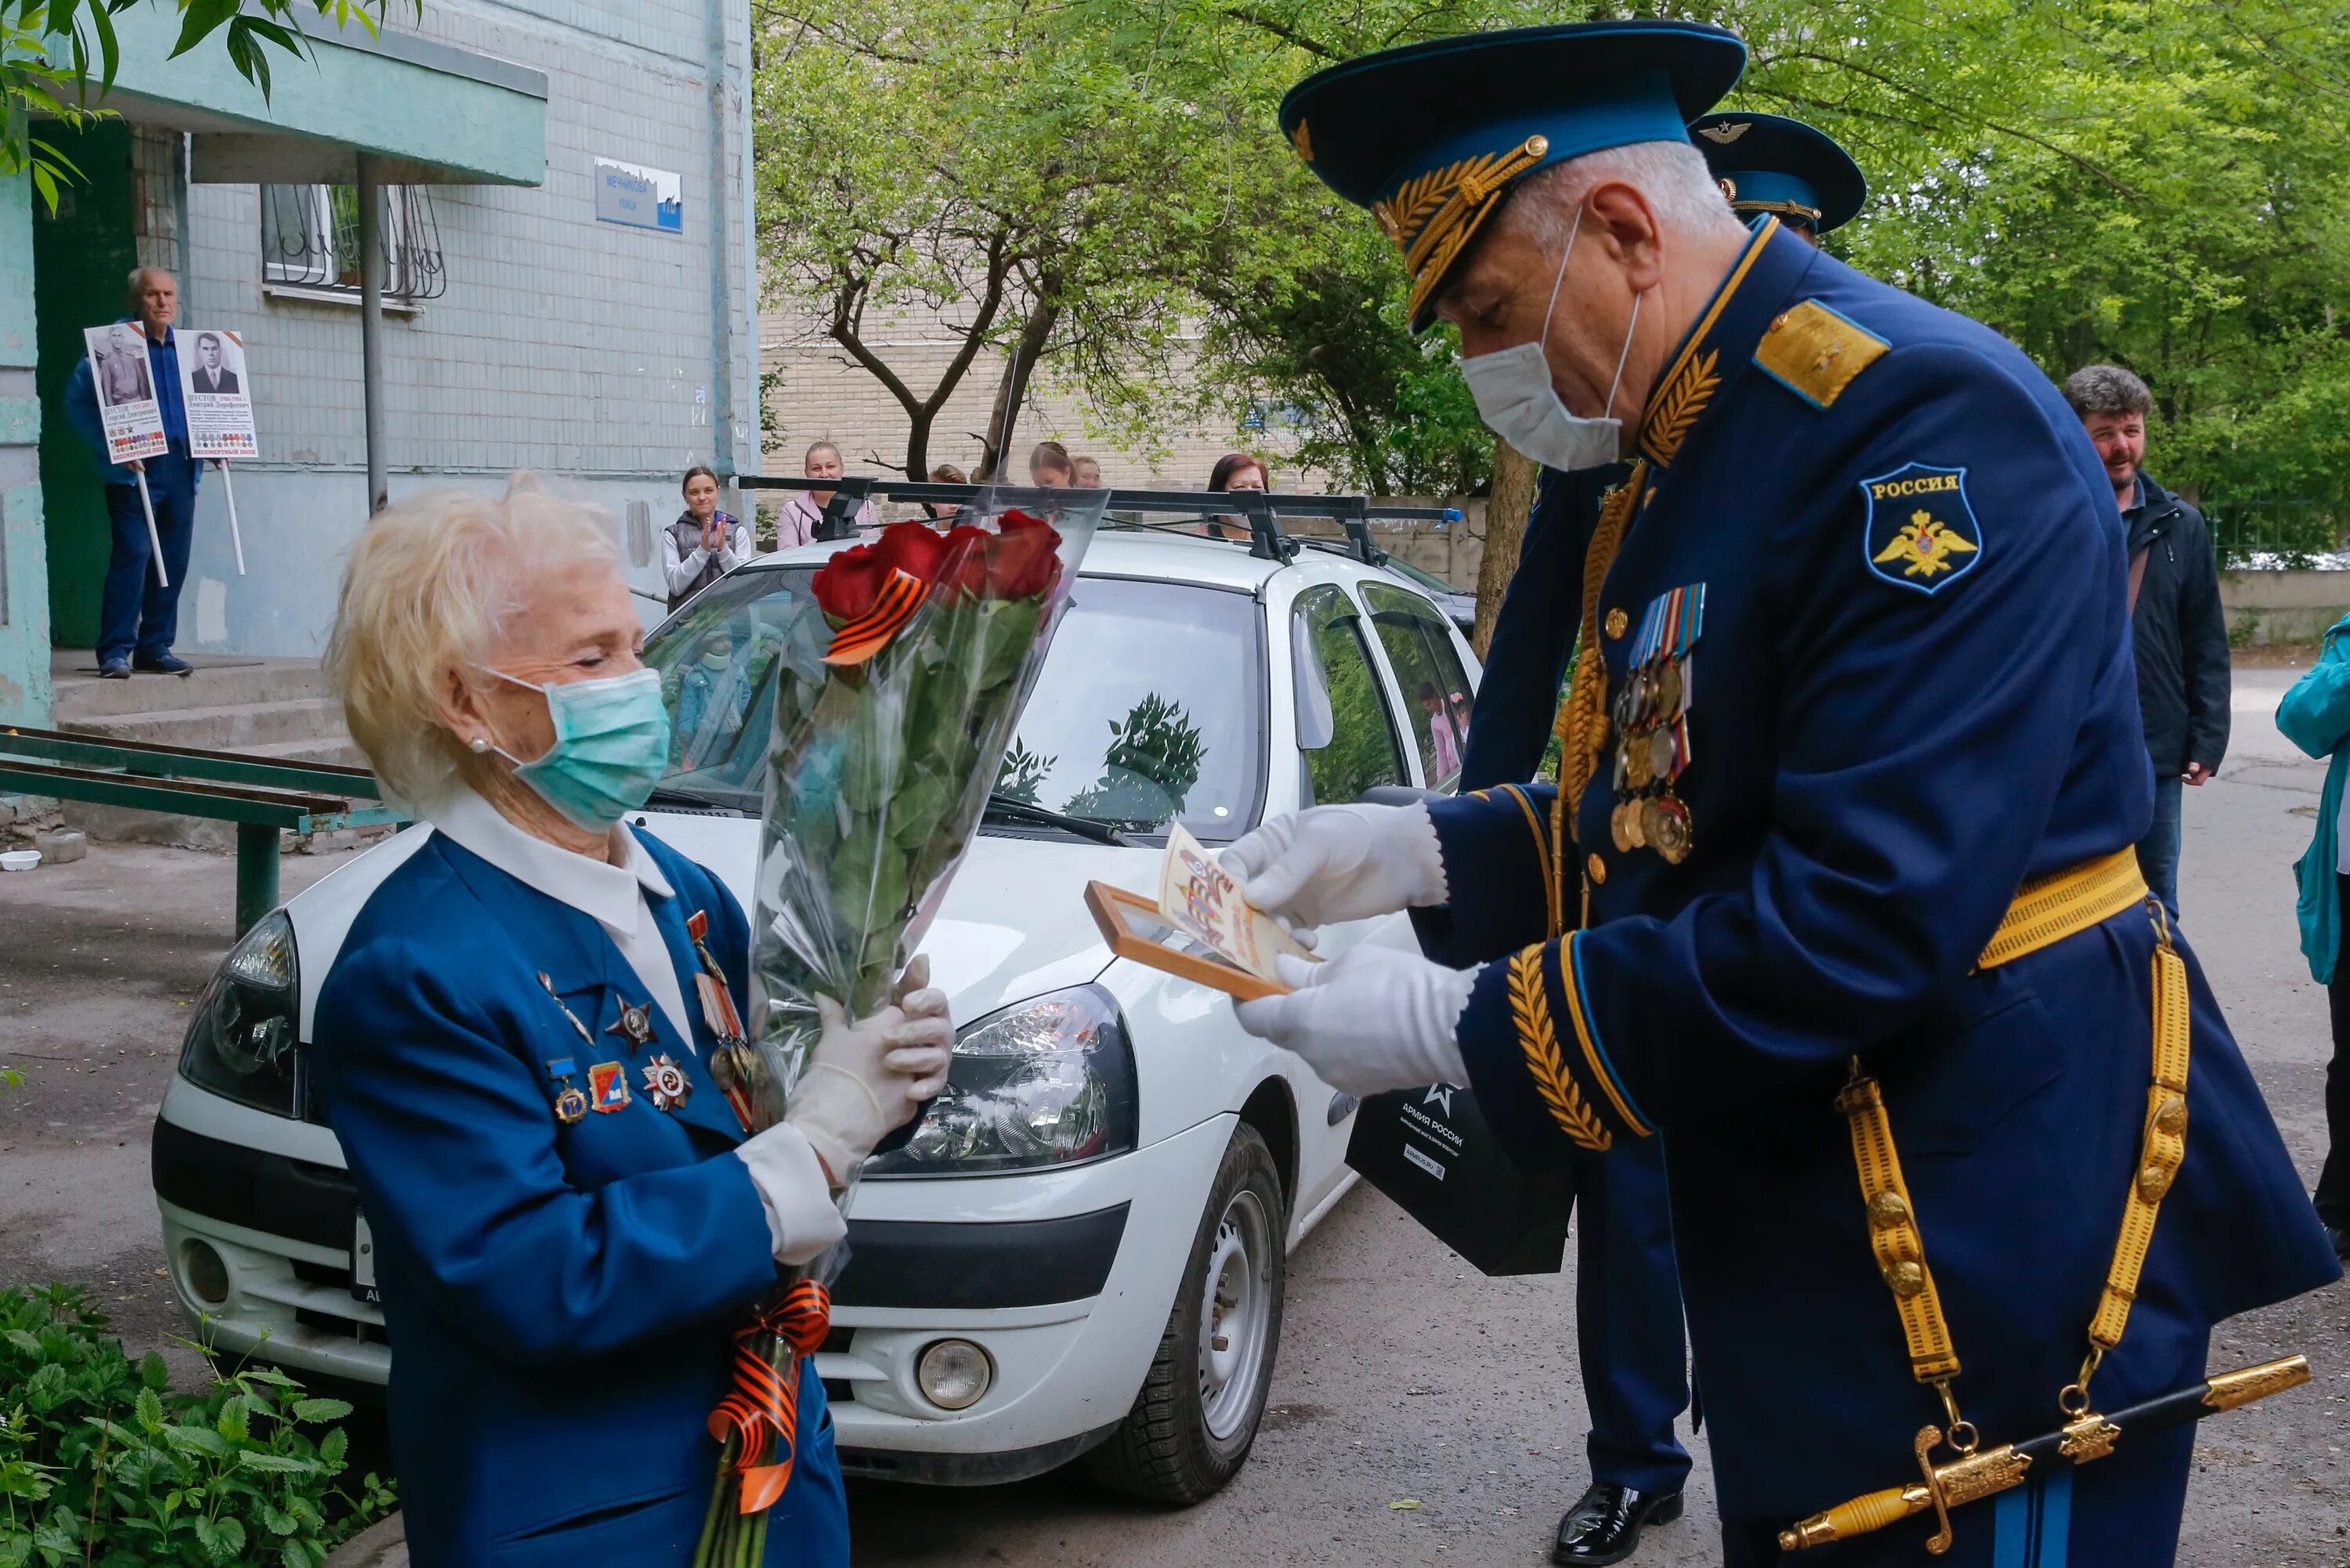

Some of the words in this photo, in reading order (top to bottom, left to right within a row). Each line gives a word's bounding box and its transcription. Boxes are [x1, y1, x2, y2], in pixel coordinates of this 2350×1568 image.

[1871, 475, 1958, 500] РОССИЯ
[1402, 1103, 1430, 1125] АРМИЯ
[1431, 1120, 1462, 1147] РОССИИ
[1406, 1148, 1434, 1169] ARMRUS.RU
